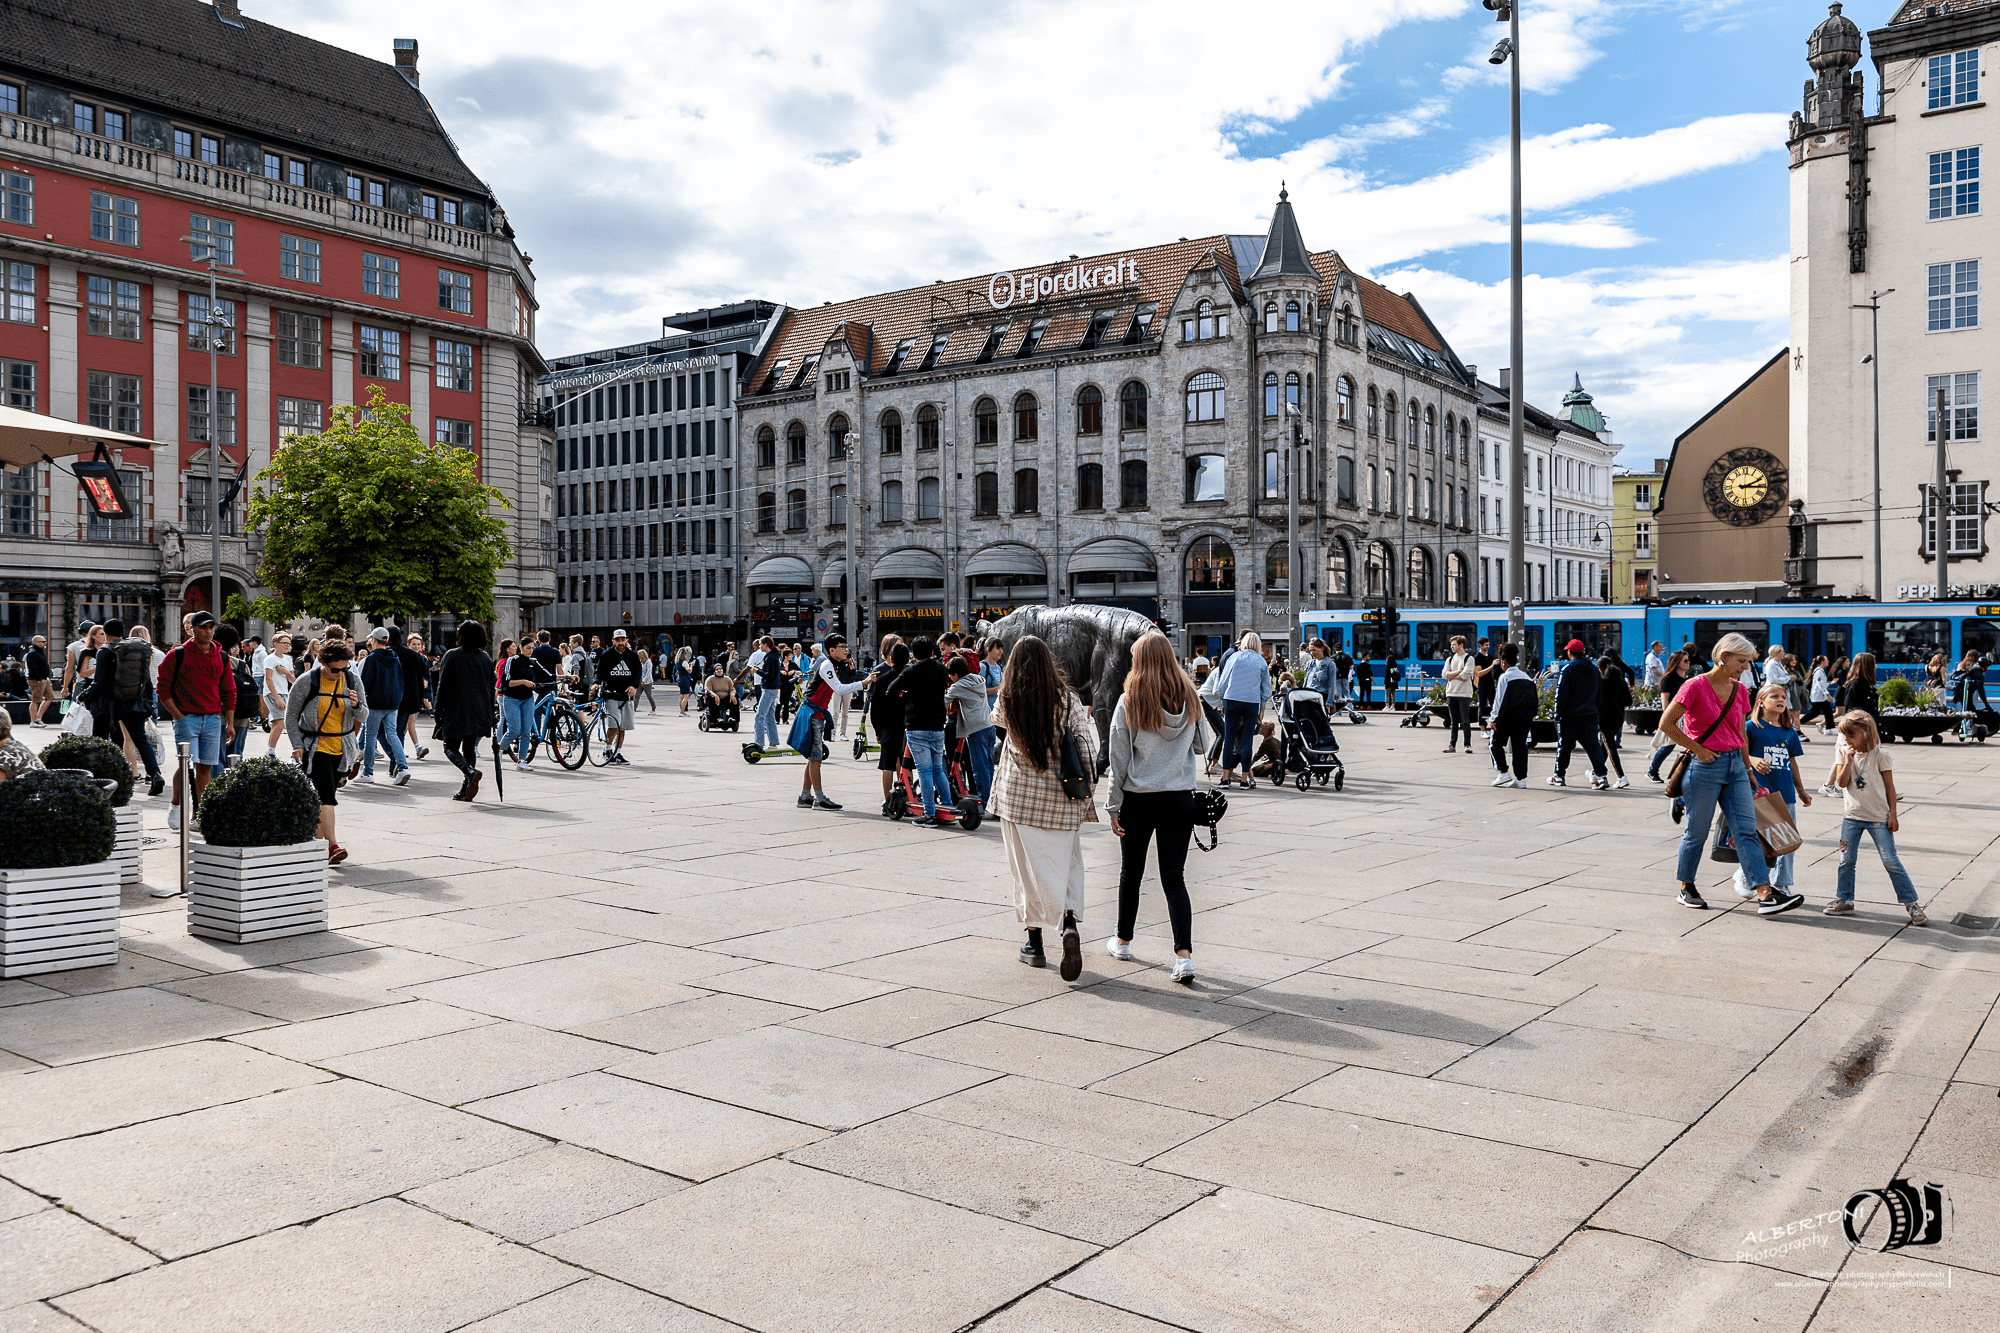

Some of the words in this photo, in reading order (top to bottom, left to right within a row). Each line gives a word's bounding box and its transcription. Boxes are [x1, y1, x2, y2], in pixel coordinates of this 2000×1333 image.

[1020, 257, 1138, 304] Fjordkraft
[683, 354, 719, 370] STATION
[879, 609, 907, 618] FOREX
[917, 607, 942, 617] BANK
[1265, 606, 1284, 617] Krogh
[827, 670, 834, 680] 3
[1759, 821, 1801, 849] ZARA
